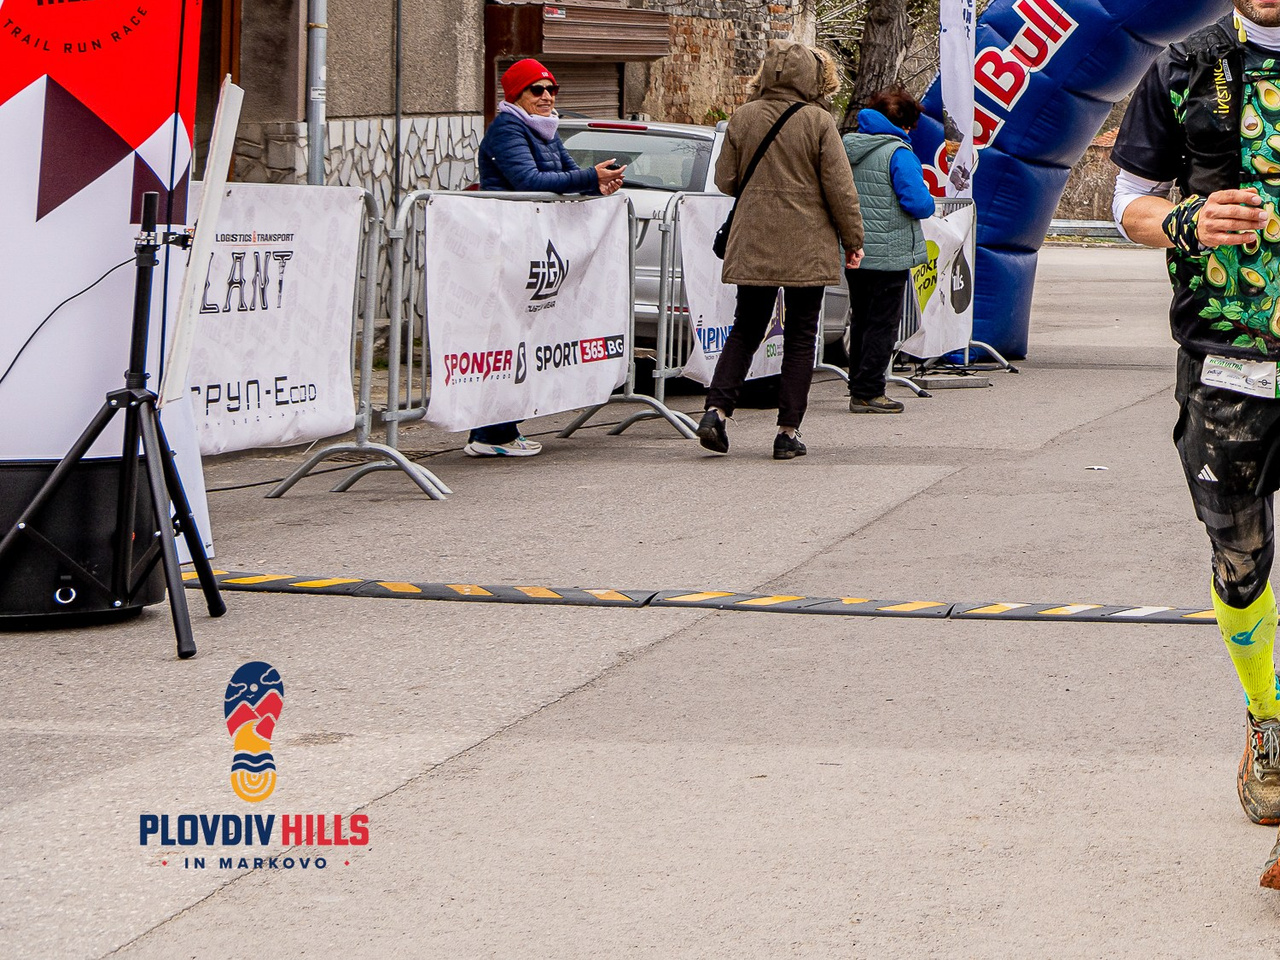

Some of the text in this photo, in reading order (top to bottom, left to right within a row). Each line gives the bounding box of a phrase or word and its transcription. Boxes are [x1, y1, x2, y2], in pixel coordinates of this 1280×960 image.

[3, 6, 148, 54] TRAIL RUN RACE
[215, 233, 295, 243] LOGISTICS TRANSPORT
[444, 349, 513, 387] SPONSER
